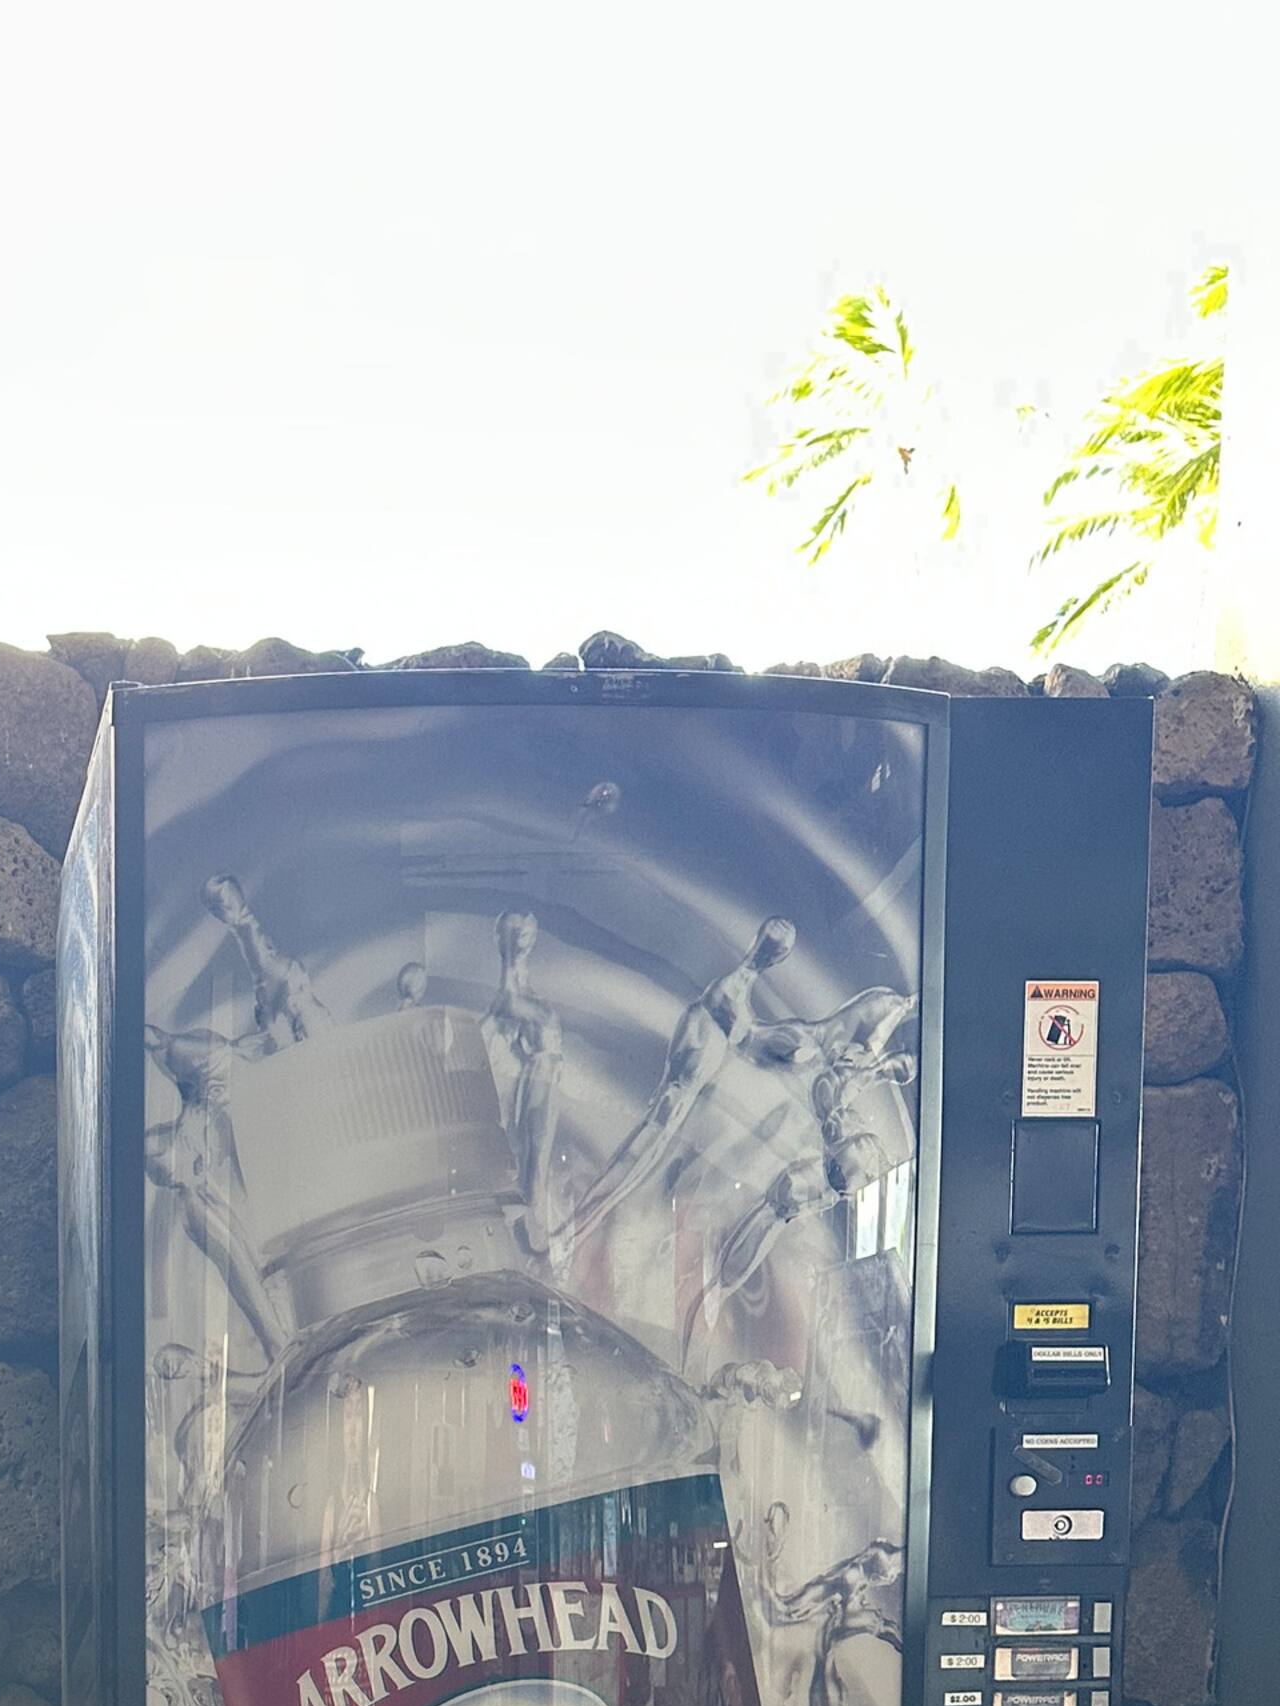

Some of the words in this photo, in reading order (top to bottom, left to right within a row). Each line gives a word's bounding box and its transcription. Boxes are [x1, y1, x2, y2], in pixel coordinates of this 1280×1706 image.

[1043, 988, 1096, 999] WARNING
[1035, 1309, 1068, 1317] ACCEPTS
[359, 1558, 446, 1600] SINCE
[461, 1537, 528, 1572] 1894
